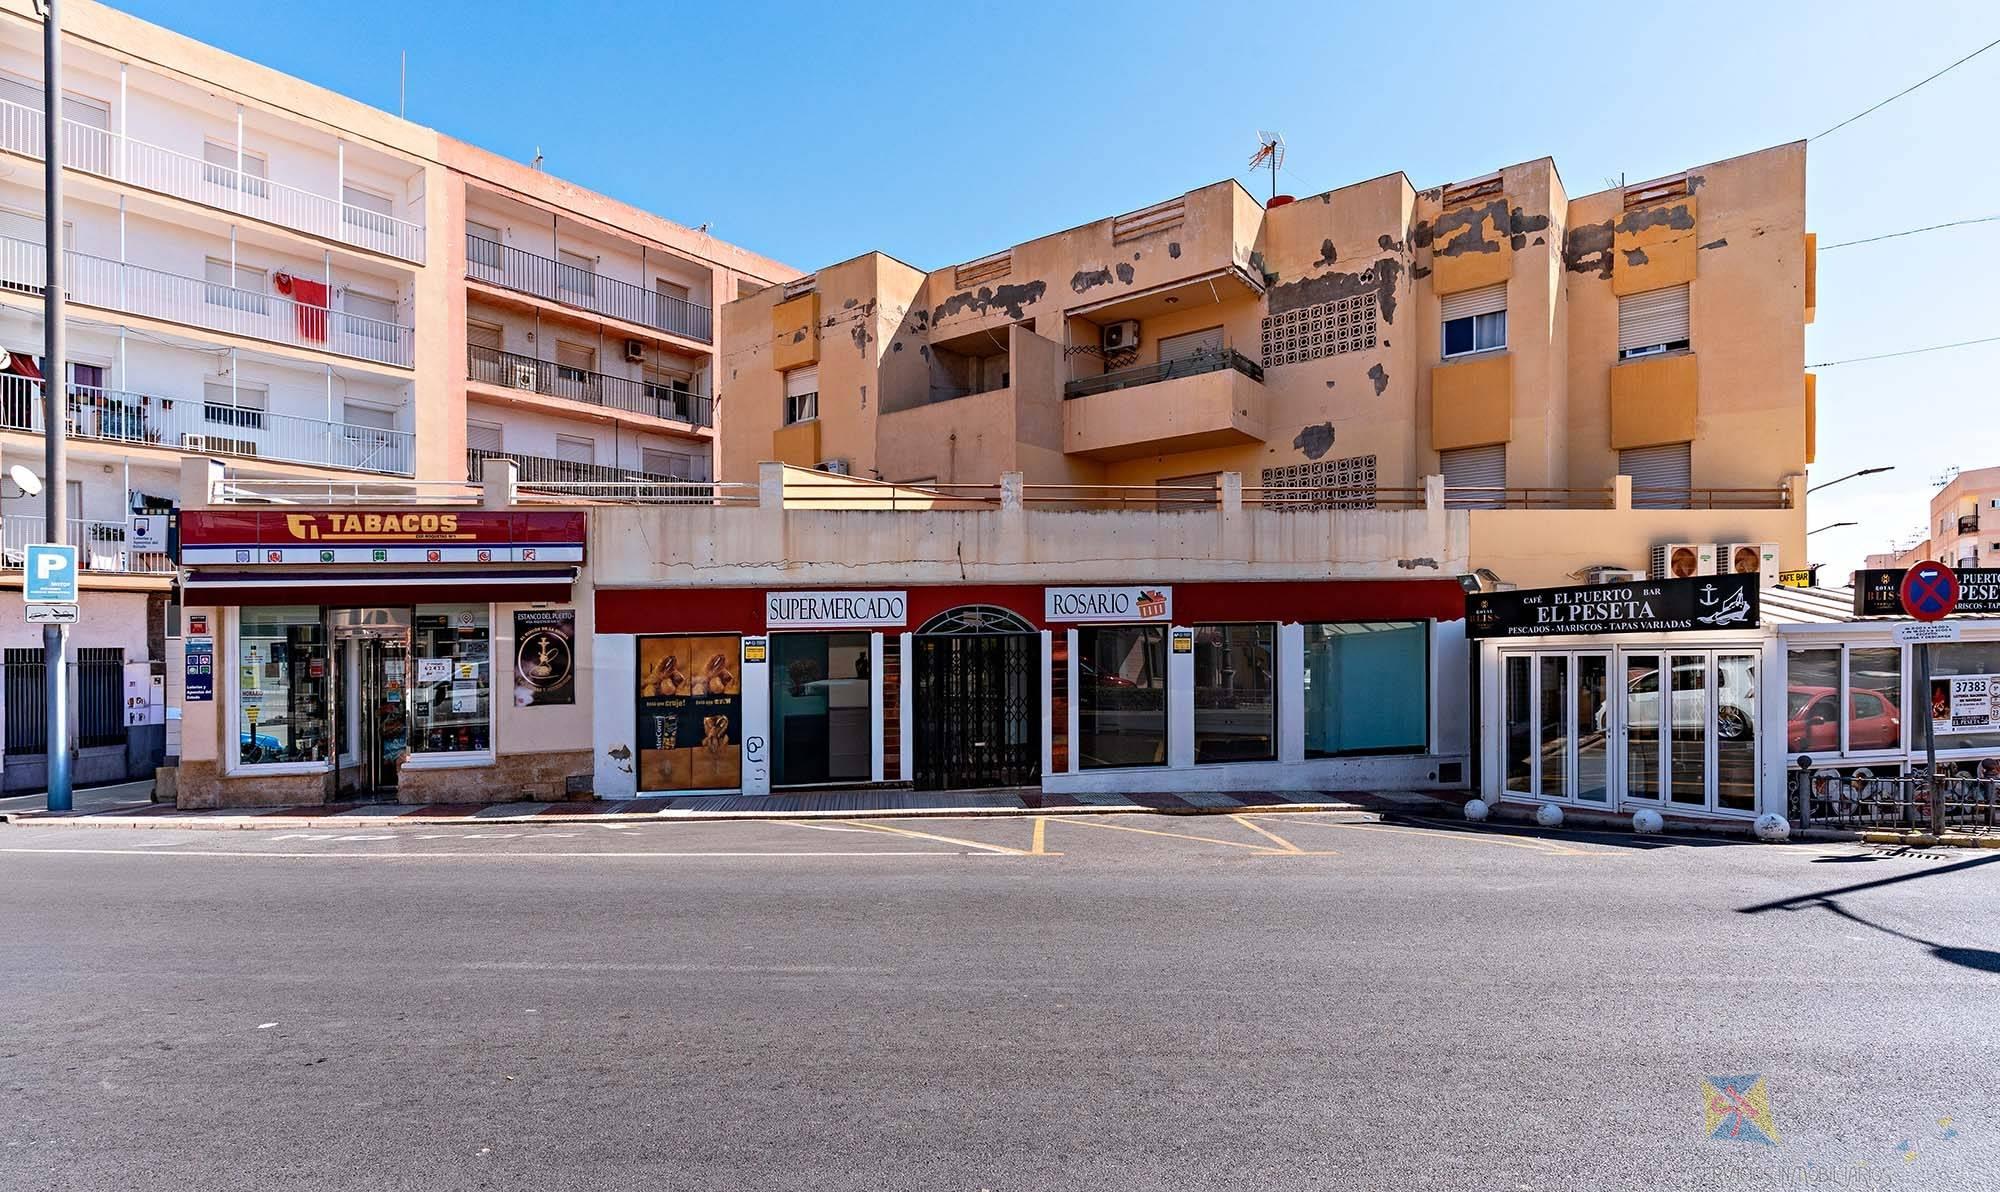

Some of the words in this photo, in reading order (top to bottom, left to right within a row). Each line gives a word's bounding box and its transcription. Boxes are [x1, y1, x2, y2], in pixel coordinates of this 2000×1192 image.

[328, 514, 458, 532] TABACOS
[38, 553, 68, 579] P
[1780, 574, 1794, 582] CAFE
[1554, 593, 1571, 604] EL
[1575, 588, 1632, 603] PUERTO
[1958, 584, 2000, 600] PESE
[770, 597, 904, 620] SUPERMERCADO
[1054, 594, 1129, 614] ROSARIO
[1537, 606, 1564, 623] EL
[1568, 601, 1655, 621] PESETA
[1508, 625, 1550, 634] PESCADOS
[1556, 623, 1602, 632] MARISCOS
[1610, 622, 1638, 630] TAPAS
[1640, 619, 1692, 629] VARIADAS
[1955, 681, 1986, 692] 37383
